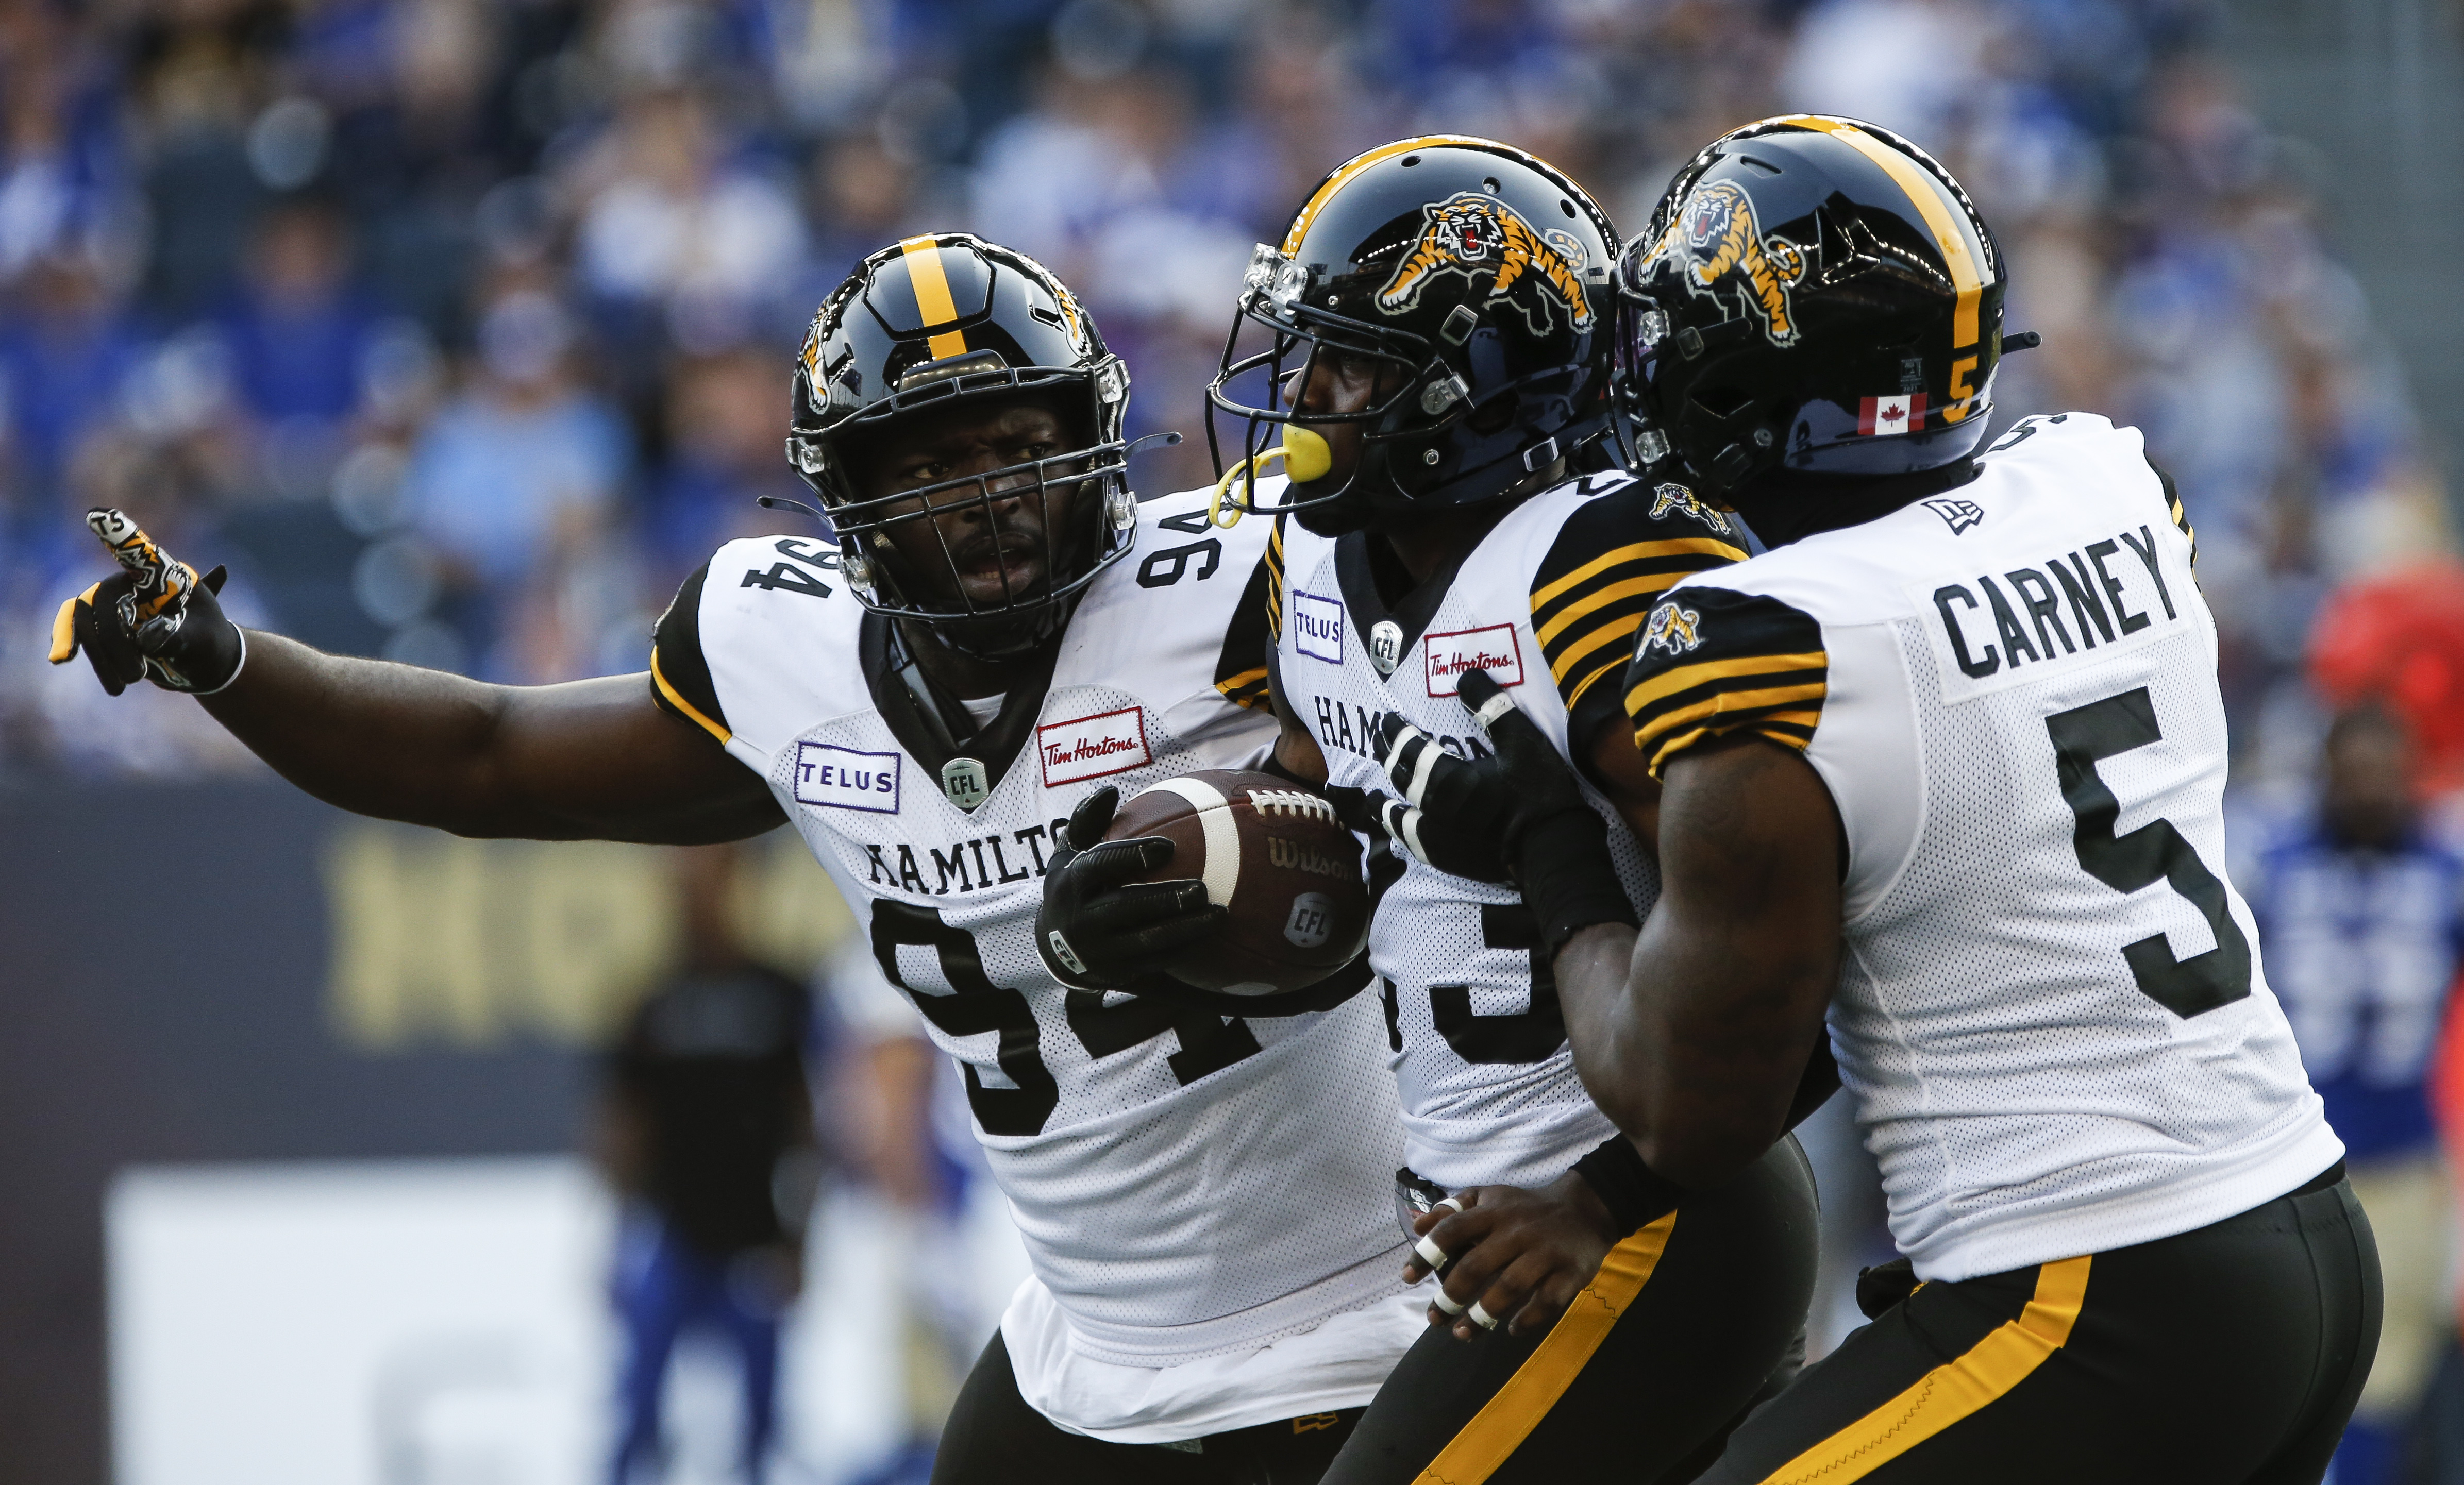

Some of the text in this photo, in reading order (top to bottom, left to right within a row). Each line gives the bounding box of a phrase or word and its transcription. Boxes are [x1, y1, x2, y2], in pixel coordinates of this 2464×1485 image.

[1943, 355, 1978, 424] 5
[90, 510, 125, 537] TS
[740, 539, 840, 599] 94
[1933, 525, 2177, 679] CARNEY
[1296, 612, 1340, 643] TELUS
[1375, 637, 1394, 661] CFL
[1430, 653, 1449, 677] Tim
[1045, 742, 1071, 766] Tim
[800, 763, 893, 794] TELUS
[949, 774, 980, 796] CFL
[2045, 686, 2251, 1020] 5
[1294, 908, 1326, 936] CFL
[1053, 939, 1076, 969] CFL
[871, 898, 1264, 1137] 94
